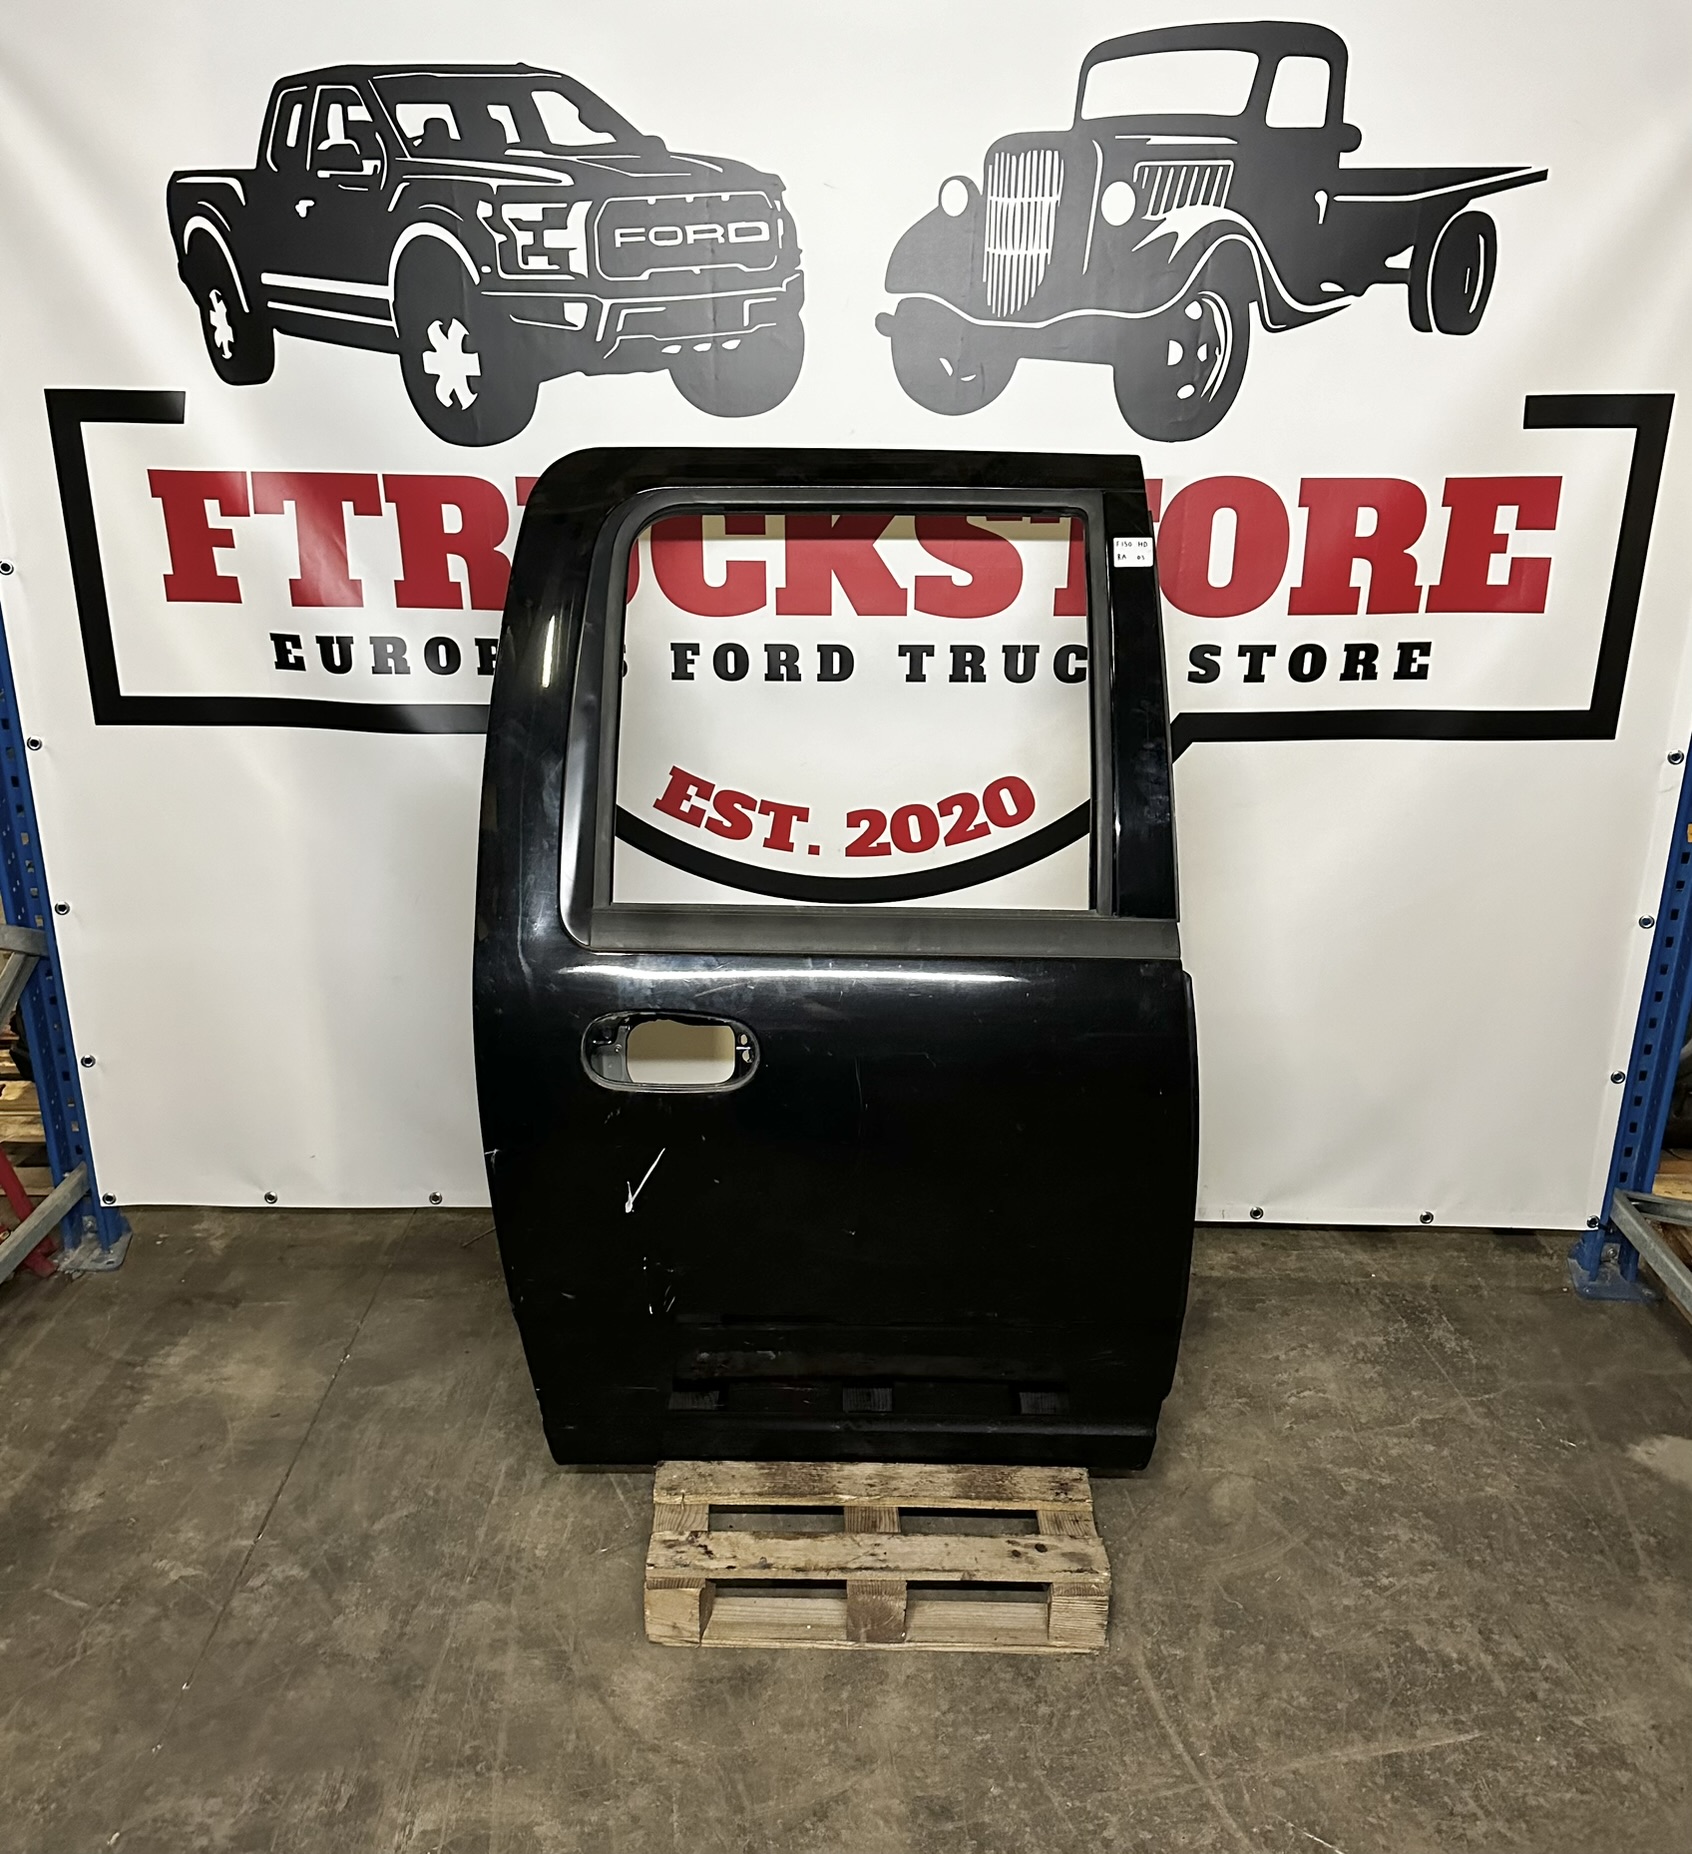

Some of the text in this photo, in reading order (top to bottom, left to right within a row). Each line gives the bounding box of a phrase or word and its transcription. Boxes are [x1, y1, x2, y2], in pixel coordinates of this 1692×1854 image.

[614, 221, 770, 248] FORD
[670, 643, 855, 682] FORD
[898, 644, 1088, 684] TRUC
[1187, 641, 1432, 684] STORE
[653, 765, 1036, 858] EST. 2020
